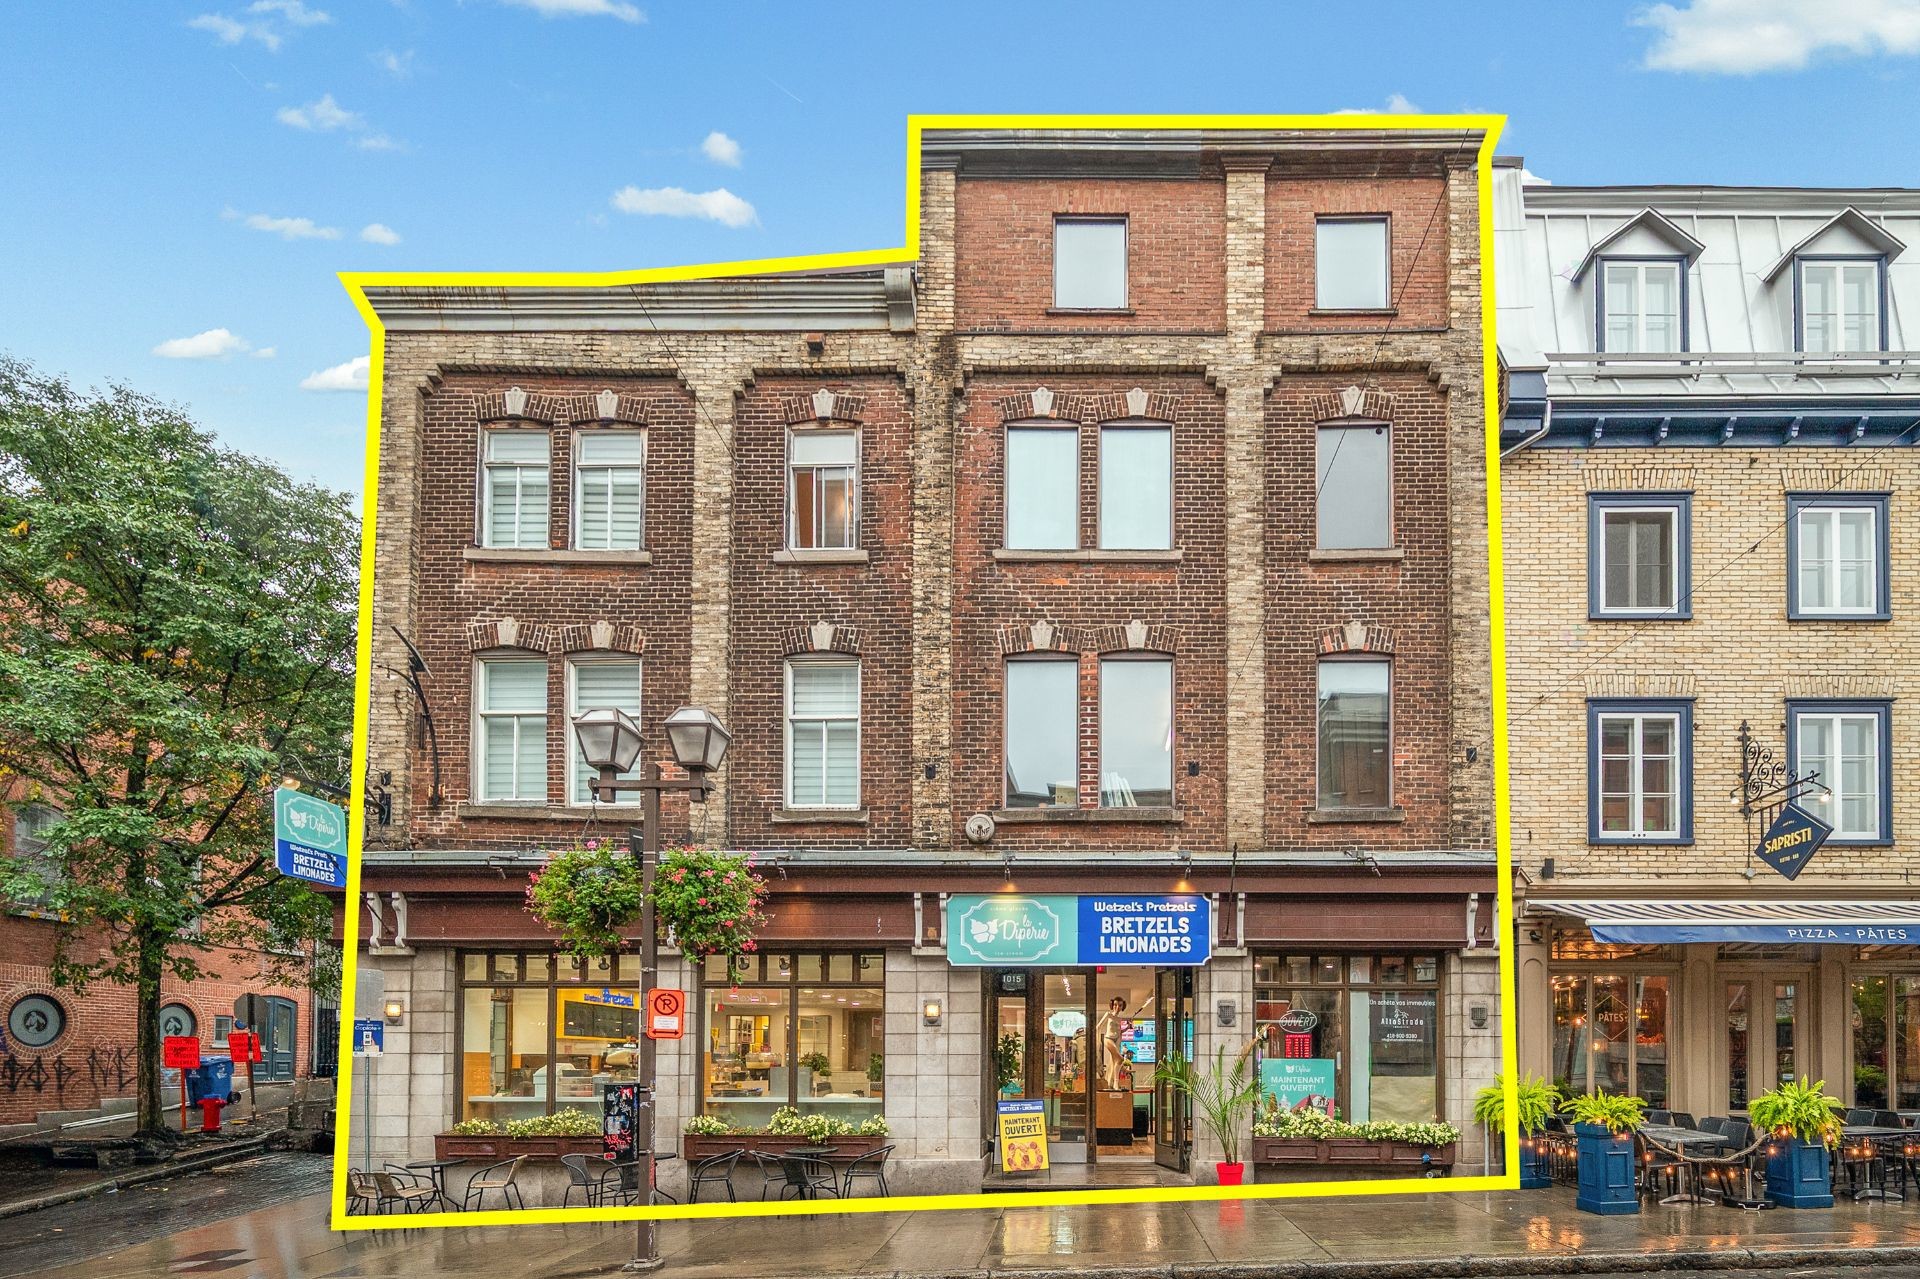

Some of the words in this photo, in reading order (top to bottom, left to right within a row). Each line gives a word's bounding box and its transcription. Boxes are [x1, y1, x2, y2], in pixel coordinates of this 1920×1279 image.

[1764, 827, 1812, 854] SAPRISTI
[293, 853, 335, 872] BRETZELS
[292, 864, 336, 883] LIMONADES
[1094, 901, 1144, 912] Wetzel's
[1146, 902, 1197, 912] Pretzels
[1022, 914, 1032, 927] la
[1101, 916, 1190, 934] BRETZELS
[1787, 929, 1838, 938] PIZZA
[1856, 927, 1907, 940] PÂTES
[1099, 936, 1192, 953] LIMONADES
[1003, 975, 1021, 983] 1015
[1281, 1016, 1315, 1027] OUVERT
[1598, 1011, 1624, 1022] PÂTES
[1270, 1076, 1325, 1084] MAINTENANT
[1280, 1084, 1316, 1092] OUVERT!
[1004, 1116, 1041, 1126] MAINTENANT
